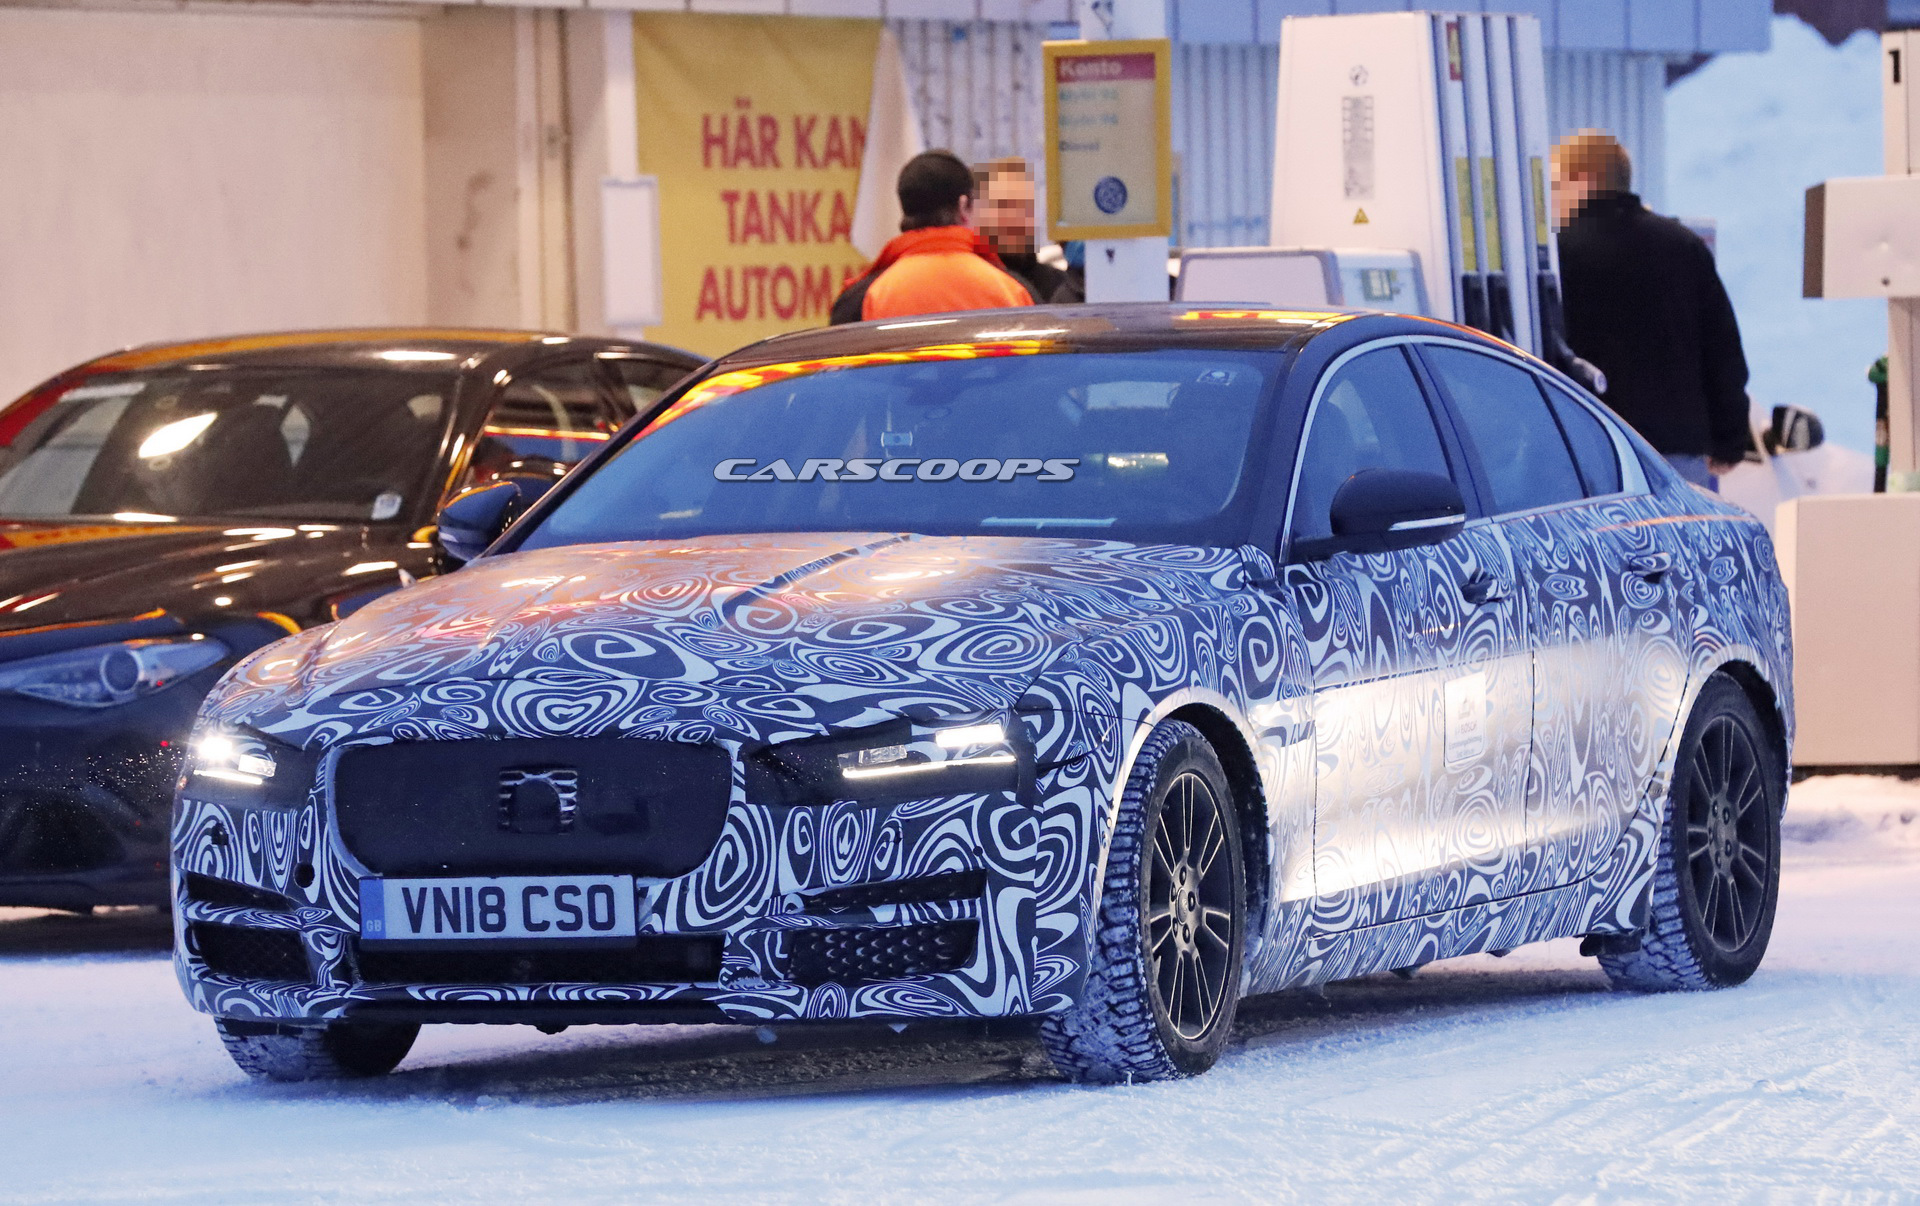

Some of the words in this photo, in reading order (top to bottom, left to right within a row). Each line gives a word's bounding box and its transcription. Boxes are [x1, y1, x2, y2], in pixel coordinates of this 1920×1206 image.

[1060, 59, 1123, 77] Konto
[1888, 49, 1901, 84] 1
[702, 97, 781, 169] HÄR
[721, 189, 852, 244] TANKA
[696, 264, 868, 320] AUTOM
[366, 920, 382, 932] GB
[402, 886, 507, 933] VN18
[521, 884, 616, 932] CSO
